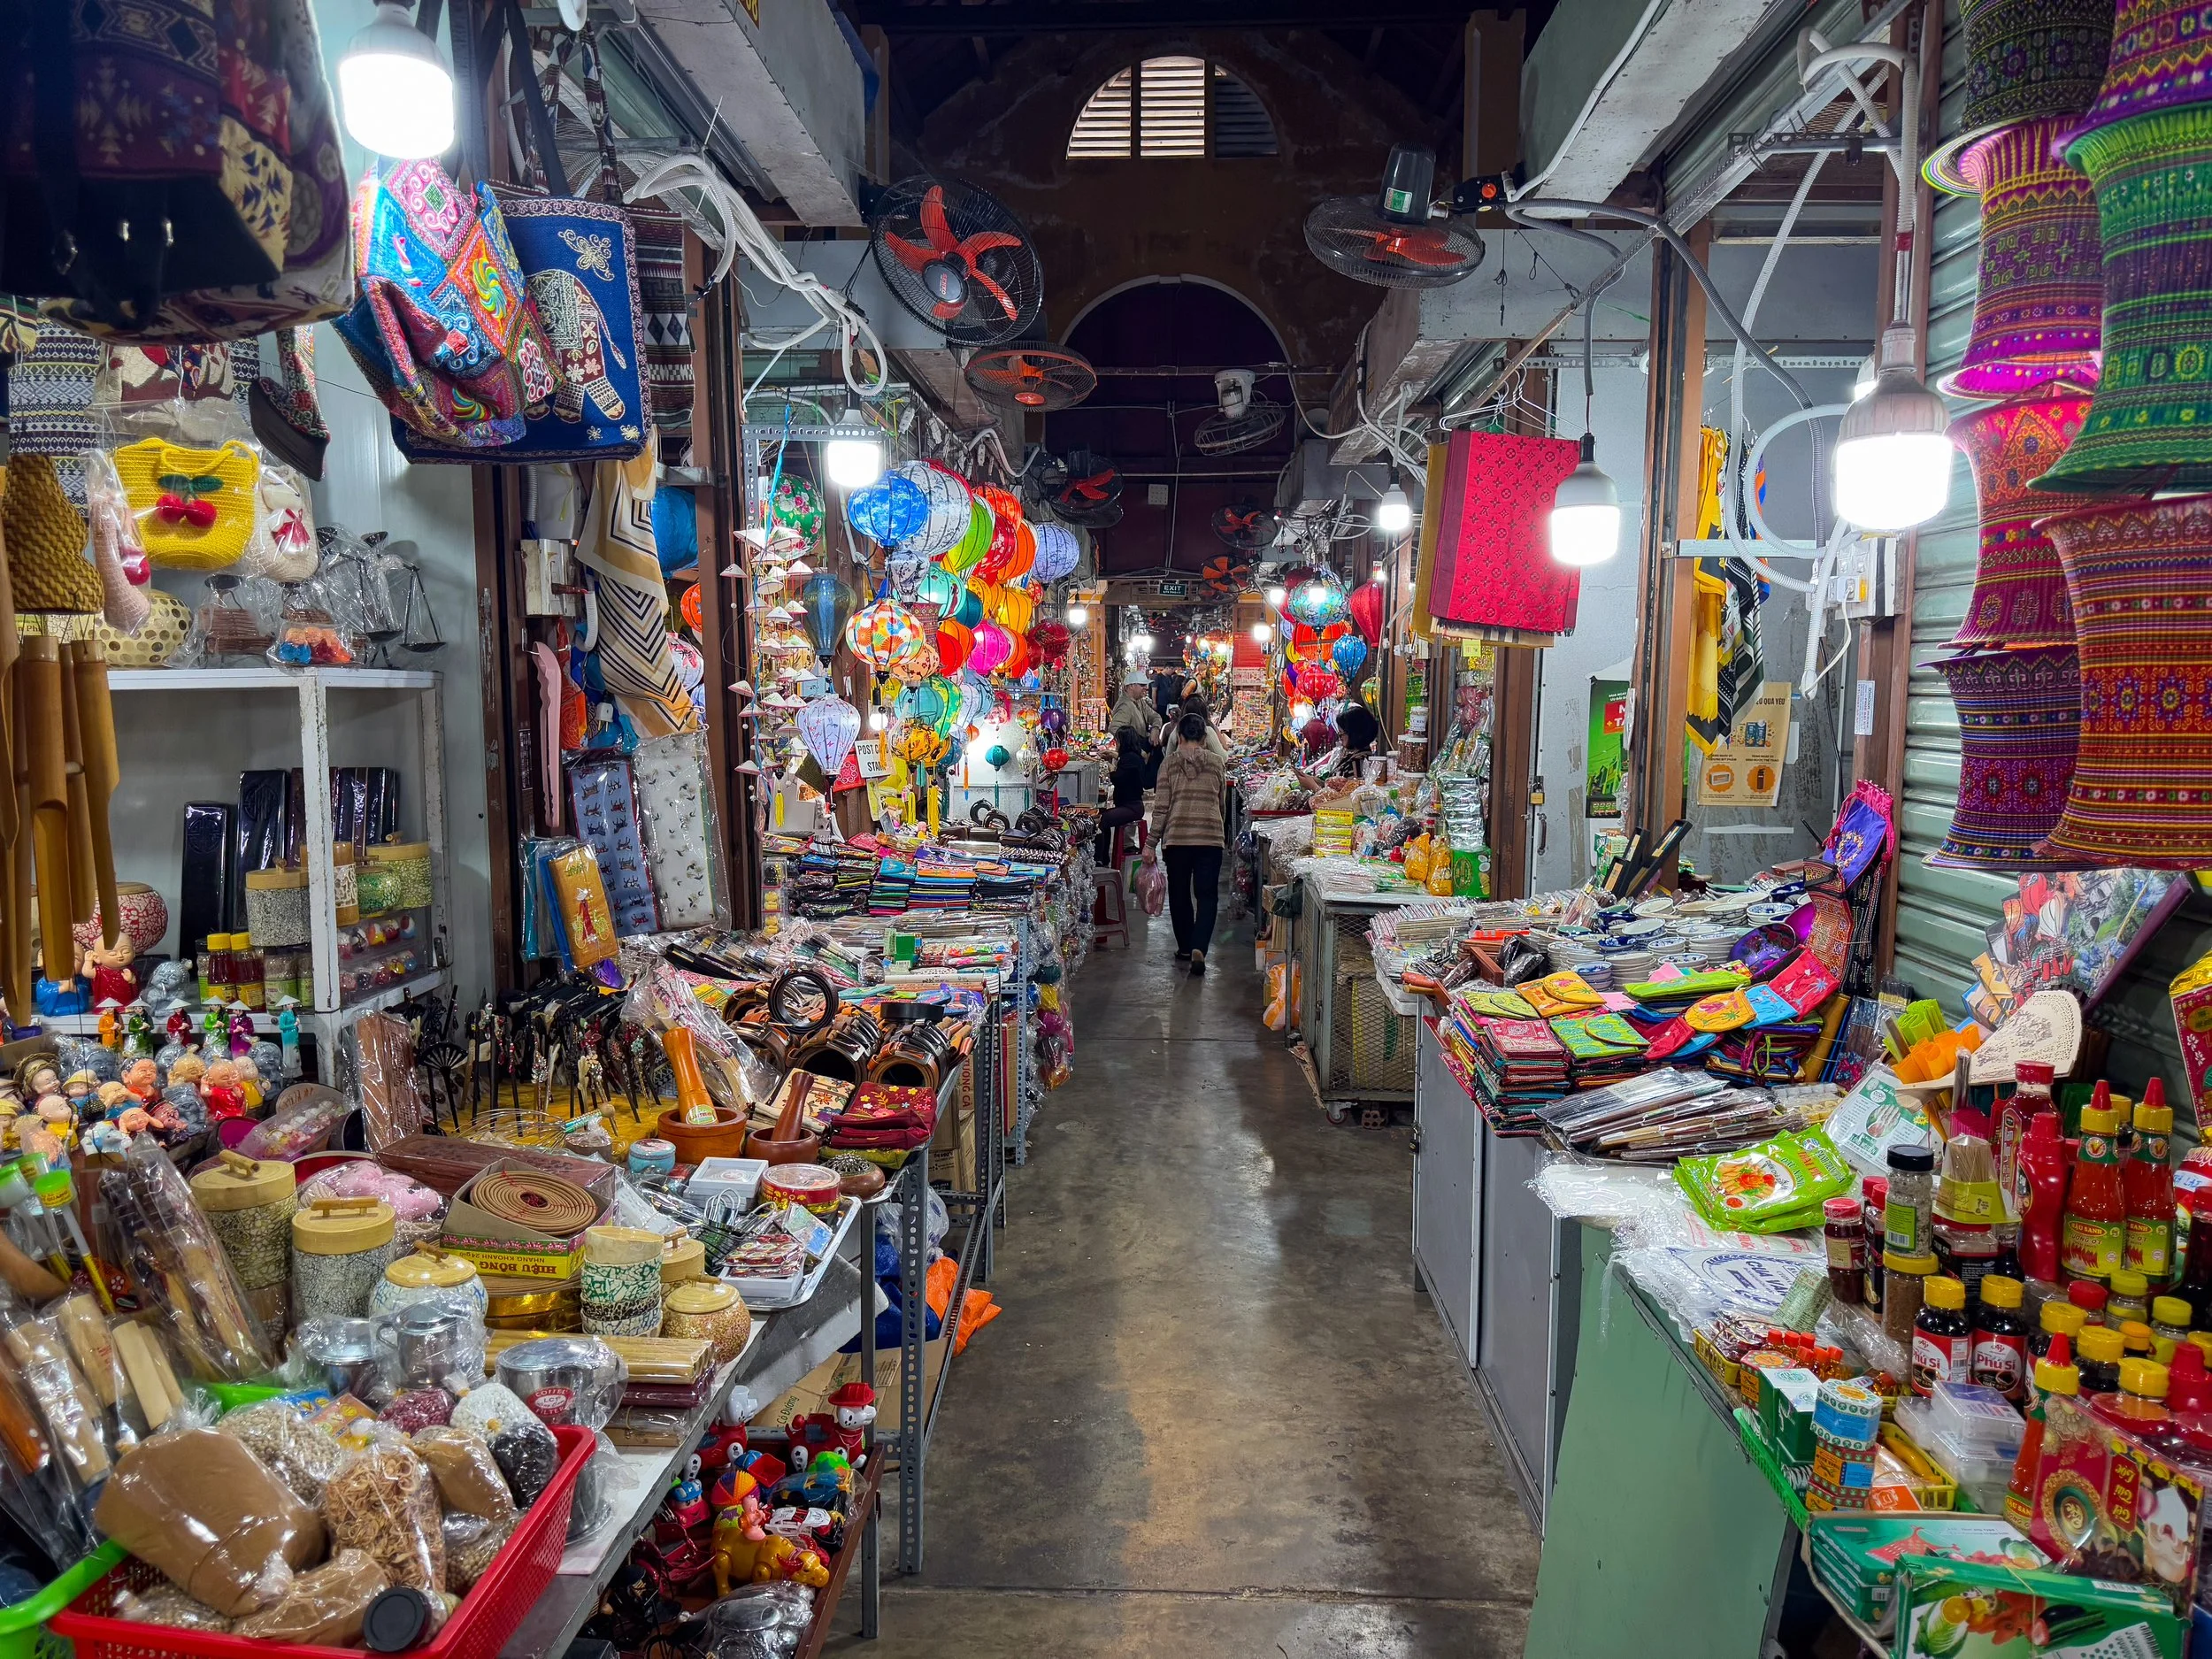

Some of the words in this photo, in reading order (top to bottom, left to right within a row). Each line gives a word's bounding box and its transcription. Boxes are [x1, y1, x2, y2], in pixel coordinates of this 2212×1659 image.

[857, 745, 873, 755] POST
[479, 1261, 518, 1272] BÔNG
[1977, 1353, 2003, 1369] Phú
